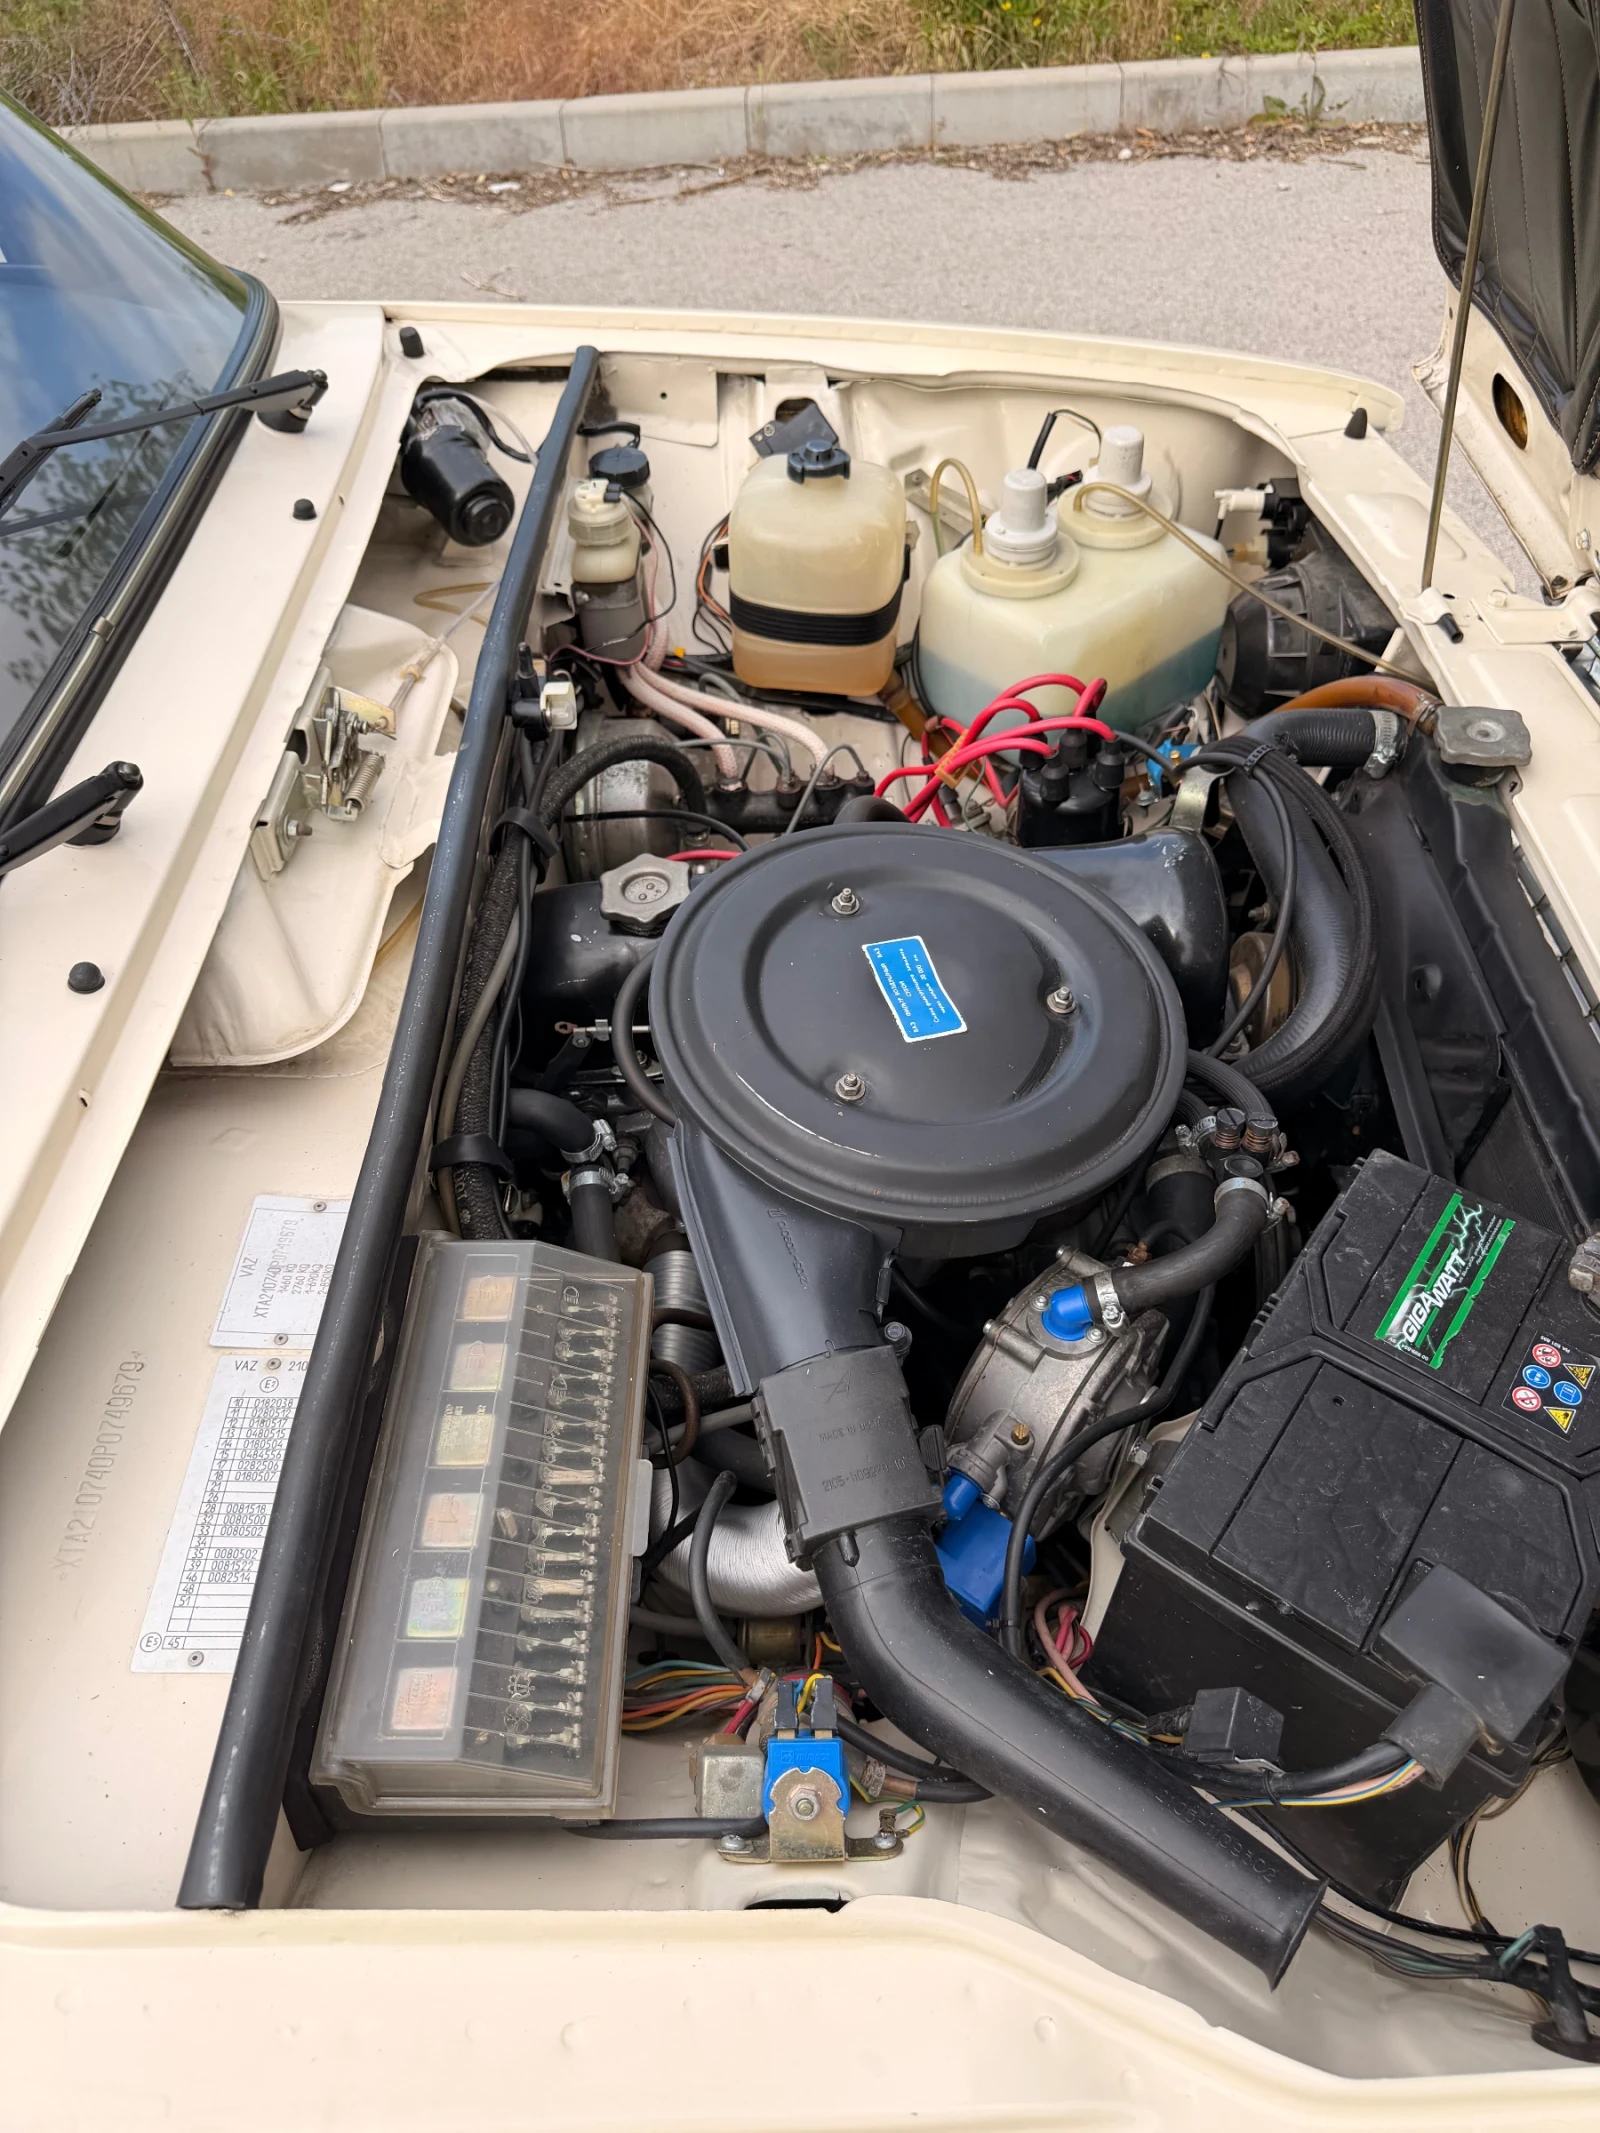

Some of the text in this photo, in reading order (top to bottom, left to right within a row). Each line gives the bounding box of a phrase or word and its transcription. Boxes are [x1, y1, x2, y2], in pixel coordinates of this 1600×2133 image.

[239, 1256, 258, 1277] VAZ
[291, 1275, 306, 1294] 2760
[1402, 1248, 1466, 1343] GIGAWATT
[235, 1360, 258, 1371] VAZ
[234, 1398, 243, 1407] 10
[230, 1408, 240, 1417] 11
[227, 1419, 238, 1428] 12
[224, 1429, 235, 1438] 13
[221, 1440, 232, 1448] 14
[218, 1450, 230, 1459] 15
[216, 1460, 227, 1470] 17
[213, 1471, 224, 1481] 18
[210, 1482, 222, 1492] 21
[207, 1492, 219, 1502] 26
[204, 1503, 216, 1514] 28
[201, 1514, 213, 1524] 32
[198, 1525, 210, 1536] 33
[195, 1537, 207, 1547] 34
[192, 1548, 204, 1559] 35
[189, 1560, 201, 1570] 39
[186, 1572, 197, 1582] 46
[182, 1584, 195, 1594] 48
[178, 1596, 191, 1606] 51
[167, 1638, 180, 1648] 45
